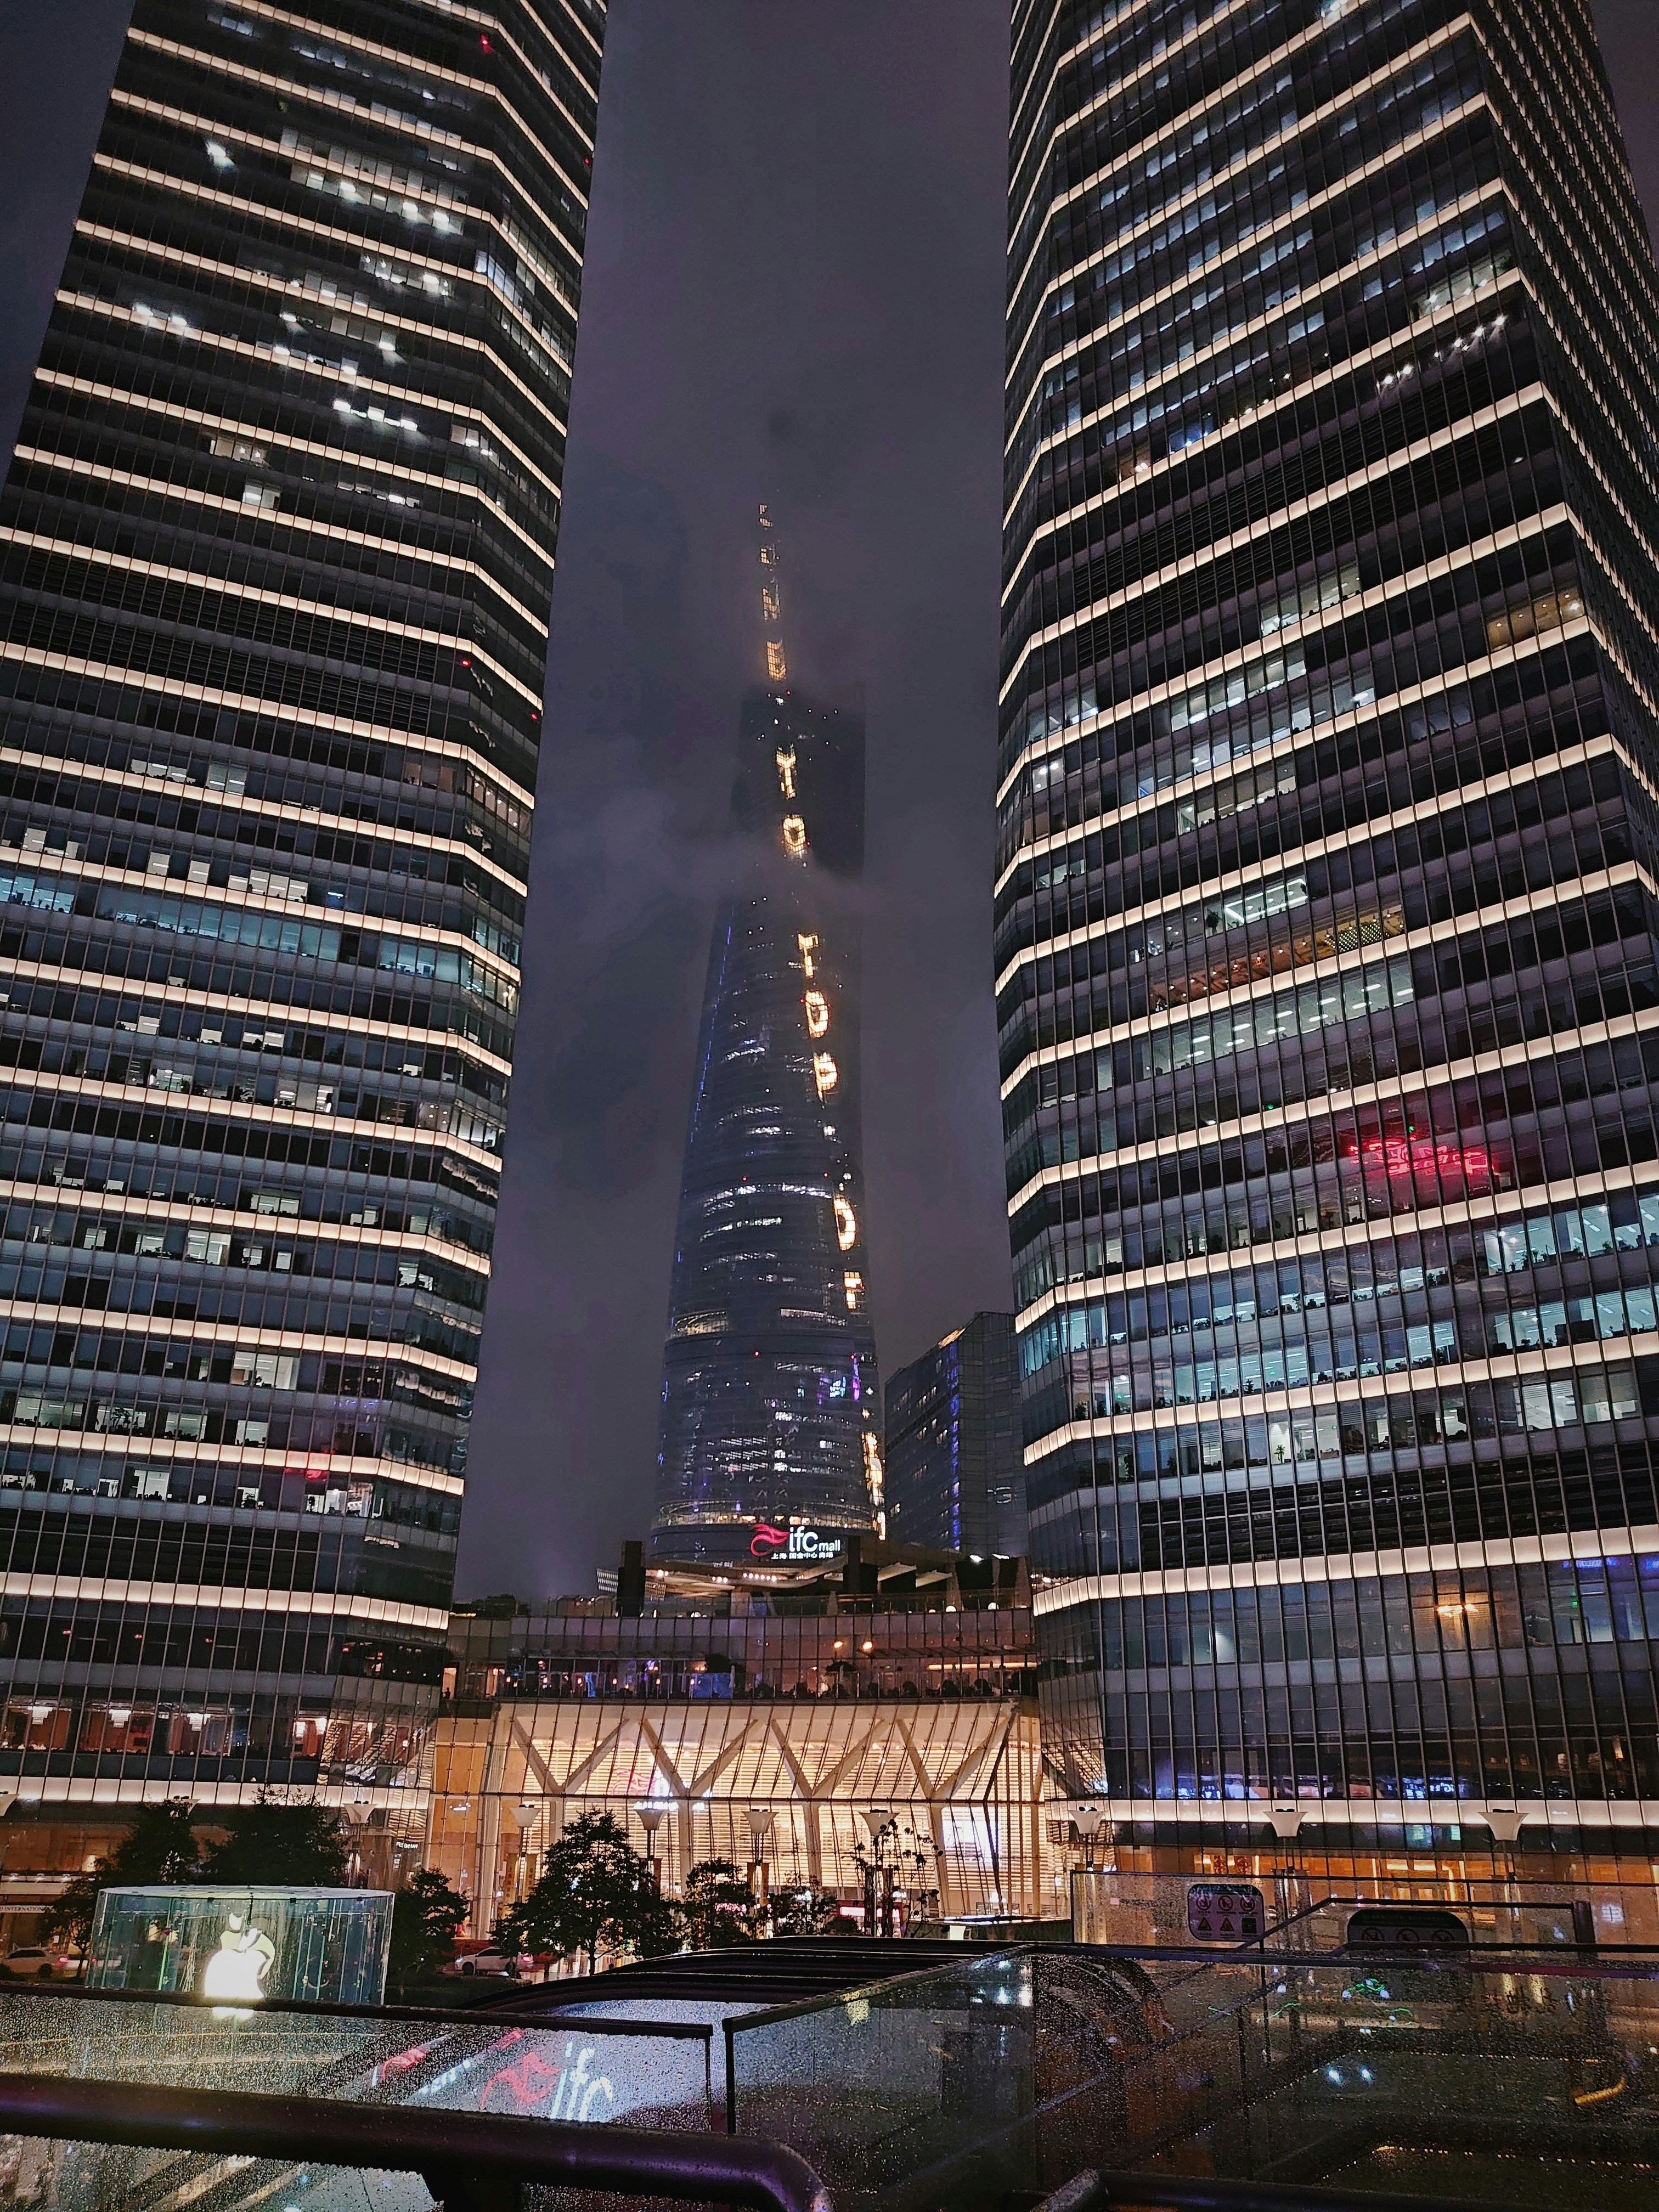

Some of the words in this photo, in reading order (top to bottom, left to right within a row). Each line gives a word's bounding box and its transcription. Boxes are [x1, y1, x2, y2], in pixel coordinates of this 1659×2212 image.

[798, 932, 838, 1102] TOP
[789, 1526, 819, 1552] ifc
[819, 1539, 840, 1551] mall
